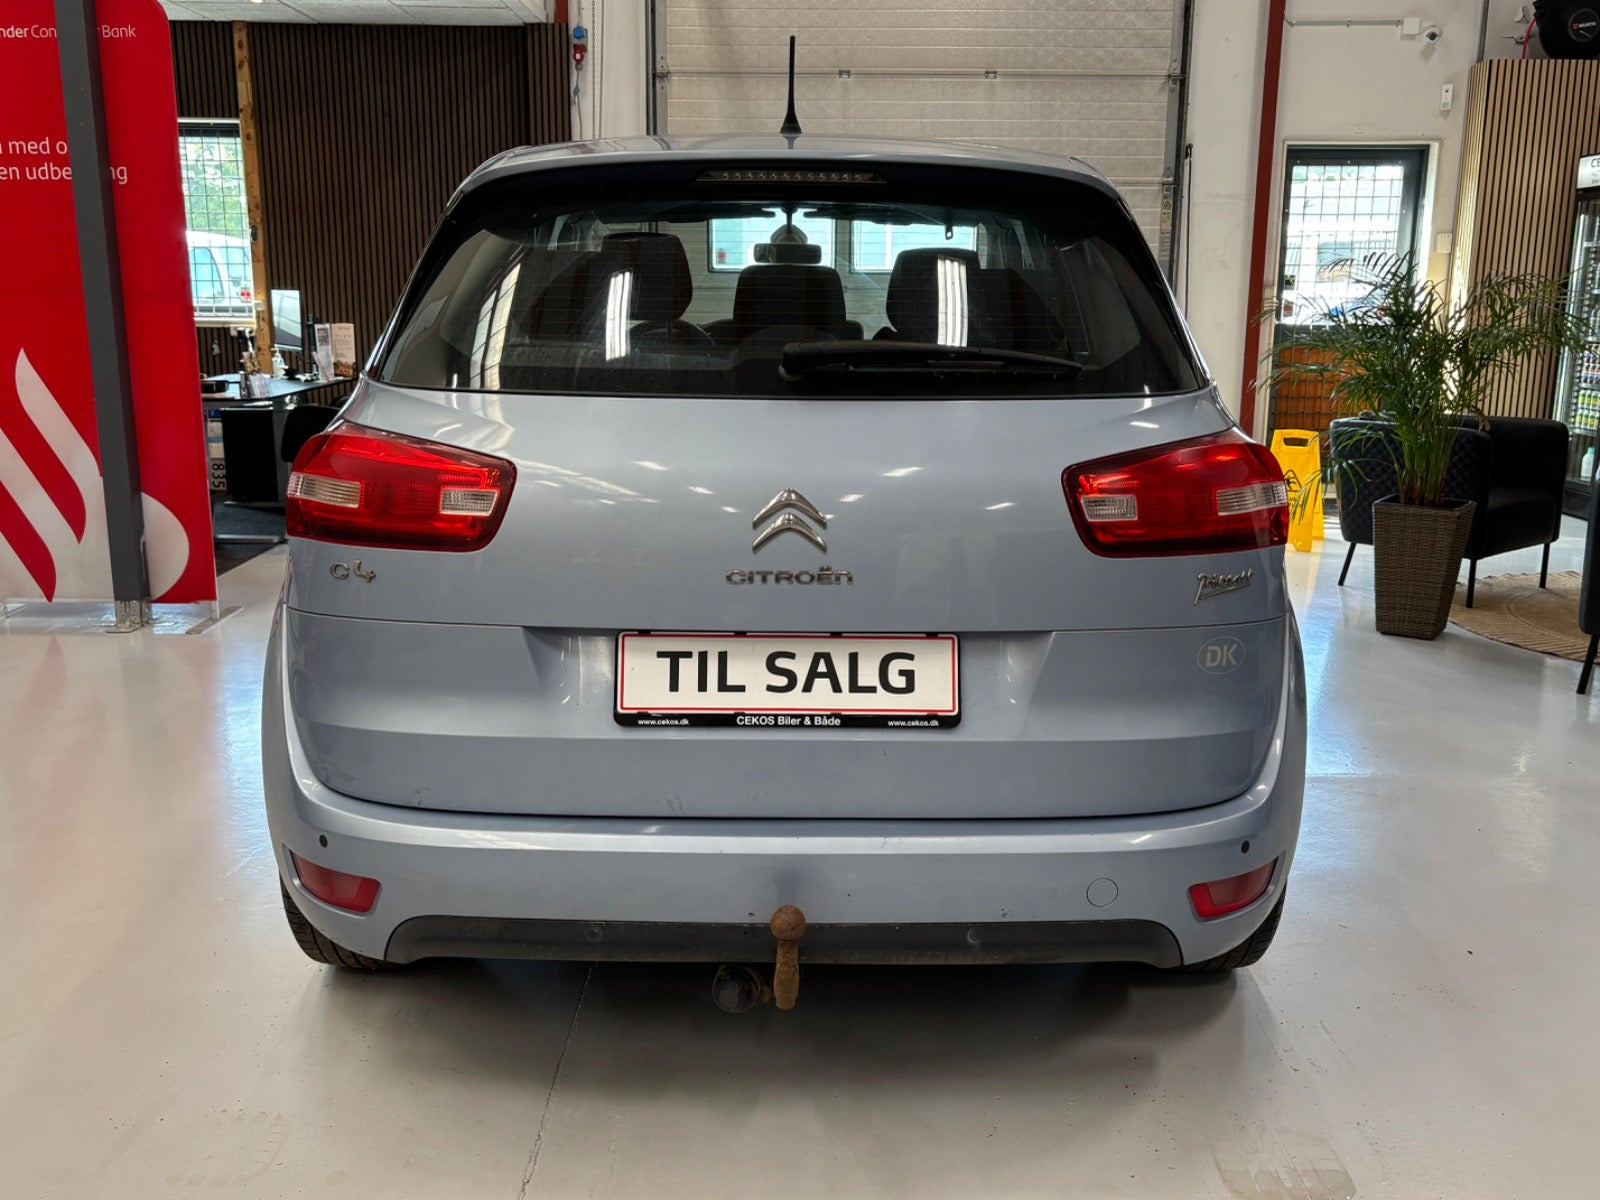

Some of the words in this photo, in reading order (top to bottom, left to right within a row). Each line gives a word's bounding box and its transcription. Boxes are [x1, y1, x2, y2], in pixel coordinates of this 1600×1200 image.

[102, 25, 136, 38] Bank
[9, 137, 50, 155] med
[329, 560, 376, 584] C4
[1206, 643, 1239, 668] DK
[656, 650, 746, 693] TIL
[765, 650, 916, 694] SALG
[638, 718, 690, 727] www.cekos.dk
[736, 716, 775, 726] CEKOS
[778, 716, 801, 726] Biler
[804, 716, 811, 726] &
[814, 715, 841, 727] Både
[887, 719, 939, 728] www.cekos.dk
